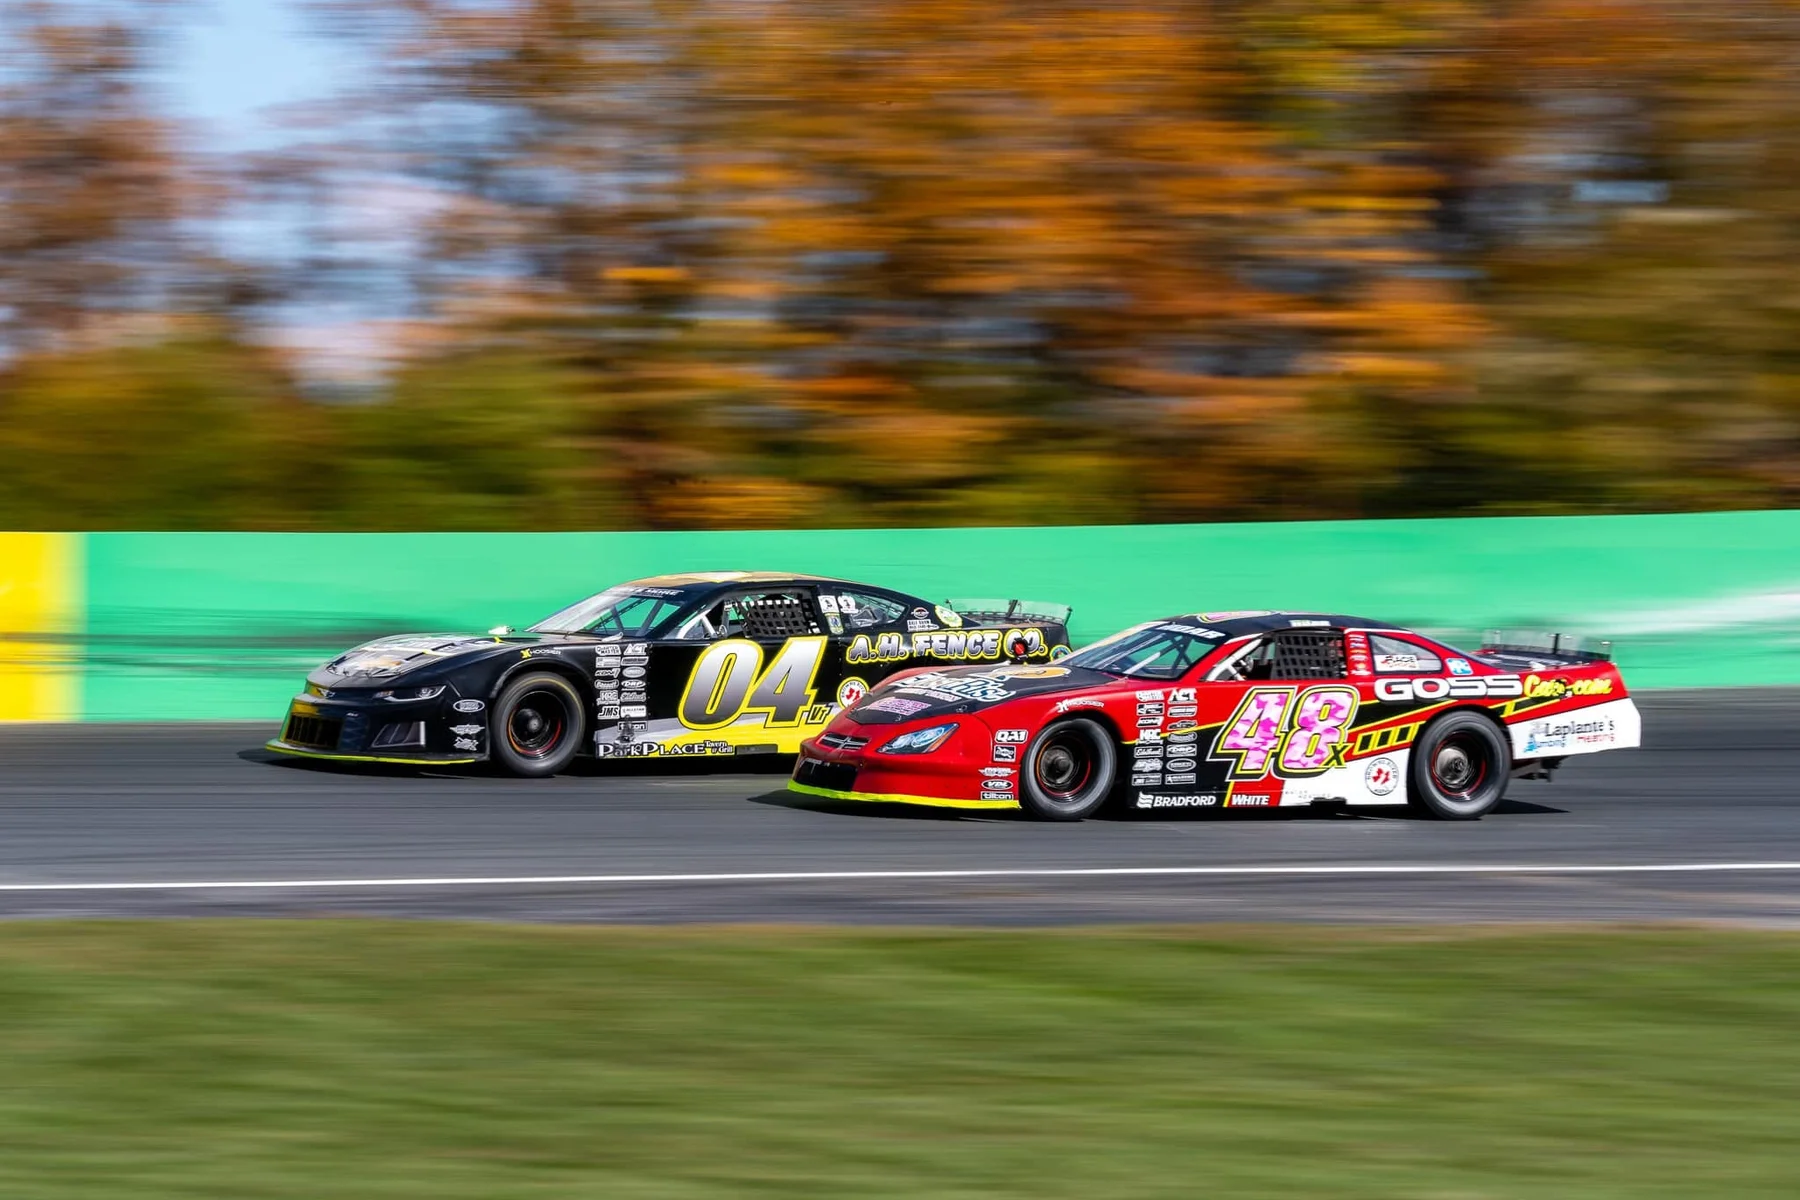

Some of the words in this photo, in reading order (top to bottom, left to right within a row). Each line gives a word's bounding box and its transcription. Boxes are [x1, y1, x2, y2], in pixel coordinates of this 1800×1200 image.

[848, 634, 908, 662] A.H.
[913, 631, 999, 659] FENCE
[678, 636, 828, 731] 04
[1374, 674, 1523, 701] GOSS
[601, 707, 619, 717] JMS
[996, 731, 1026, 742] QA1
[1215, 686, 1357, 775] 48
[1153, 795, 1217, 807] BRADFORD
[1232, 795, 1270, 806] WHITE
